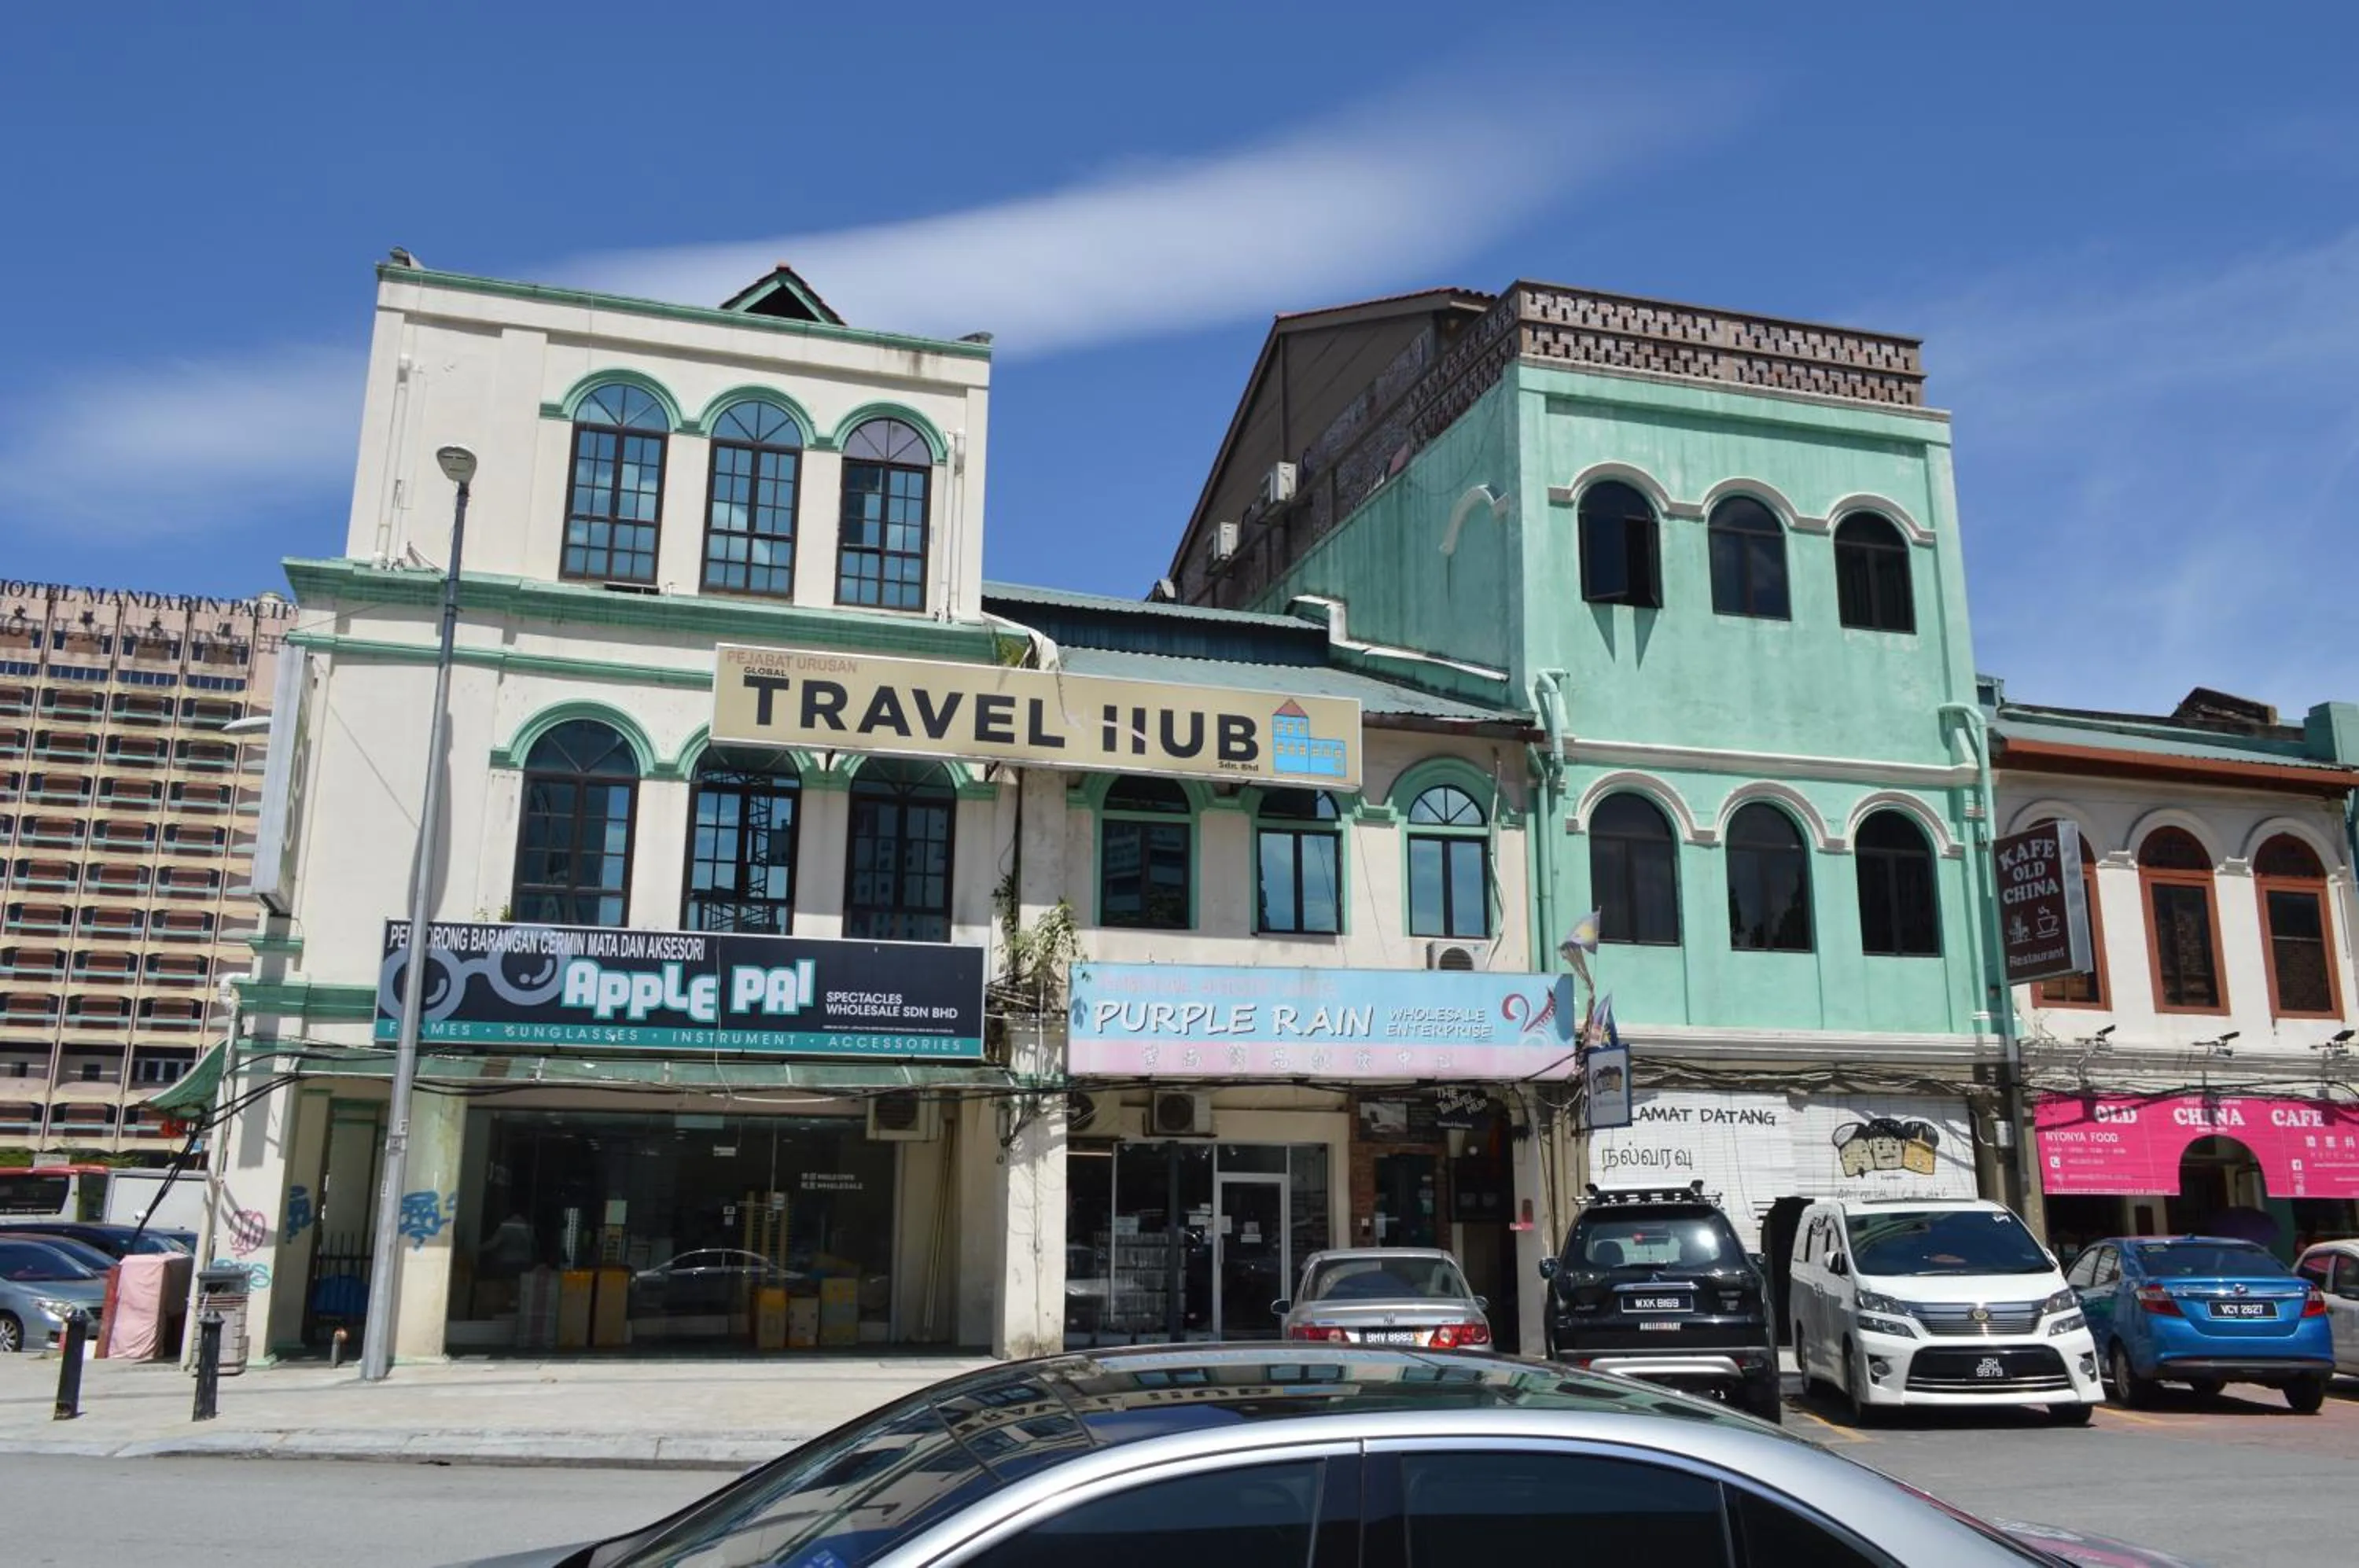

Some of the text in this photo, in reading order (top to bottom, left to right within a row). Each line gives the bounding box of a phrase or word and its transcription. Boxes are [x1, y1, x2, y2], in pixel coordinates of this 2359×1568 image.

[84, 586, 221, 614] MANDARIN
[727, 650, 859, 674] PEJABAT URUSAN
[743, 666, 786, 677] GLOBAL
[743, 675, 1259, 762] TRAVEL HUB
[1998, 838, 2057, 870] KAFE
[2012, 860, 2046, 882] OLD
[2003, 878, 2060, 904] CHINA
[470, 927, 538, 953] BARANGAN
[539, 930, 587, 955] CERMIN
[587, 933, 618, 956] MATA
[620, 934, 644, 958] DAN
[646, 934, 705, 961] AKSESORI
[2009, 946, 2065, 968] Restaurant
[826, 992, 903, 1004] SPECTACLES
[826, 1003, 959, 1019] WHOLESALE SDN BHD
[1094, 1000, 1375, 1037] PURPLE RAIN
[1389, 1006, 1485, 1022] WHOLESALE
[503, 1025, 639, 1043] SUNGLASSES
[672, 1031, 797, 1046] INSTRUMENT
[828, 1036, 961, 1051] ACCESSORIES
[1386, 1024, 1494, 1039] ENTERPRISE
[1700, 1108, 1776, 1126] DATANG
[2094, 1105, 2138, 1124] OLD
[2271, 1110, 2324, 1127] CAFE
[2045, 1132, 2119, 1143] NYONYA FOOD
